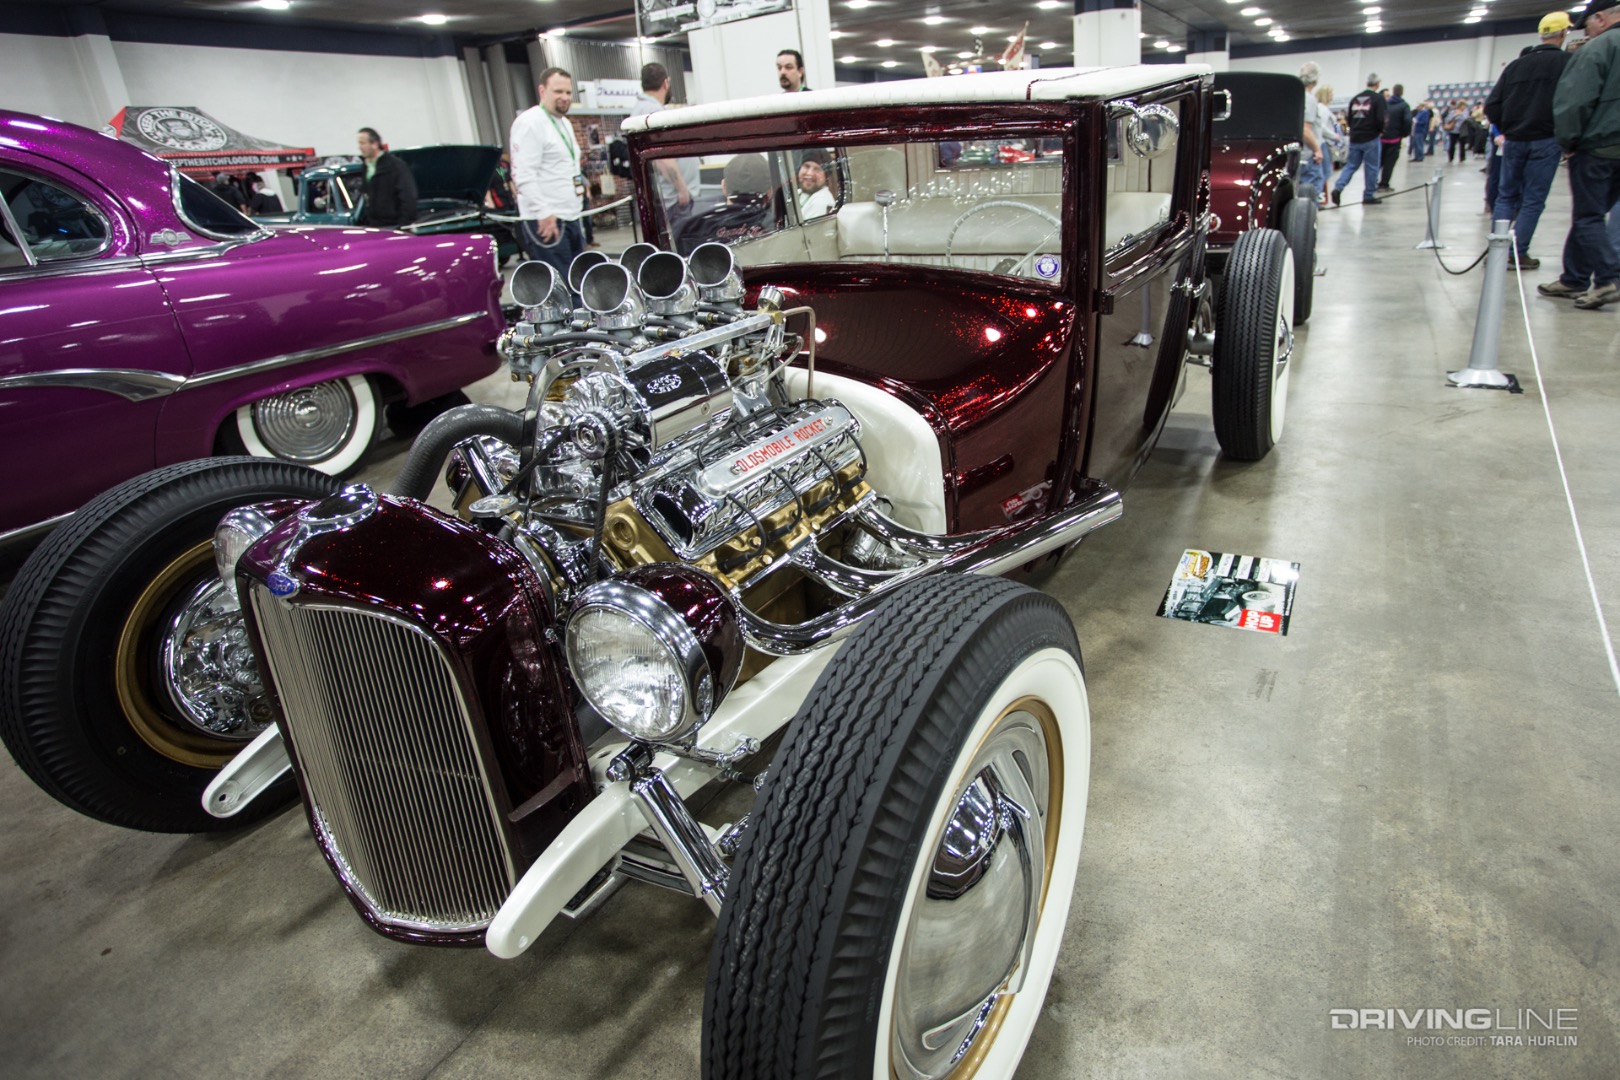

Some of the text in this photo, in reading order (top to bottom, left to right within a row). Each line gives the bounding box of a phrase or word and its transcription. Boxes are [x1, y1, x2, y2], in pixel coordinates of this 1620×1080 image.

[141, 109, 218, 133] KEEP THE BITCH
[735, 418, 827, 473] OLDSMOBILE ROCKET
[1244, 610, 1260, 630] HOP
[1259, 615, 1275, 629] UP
